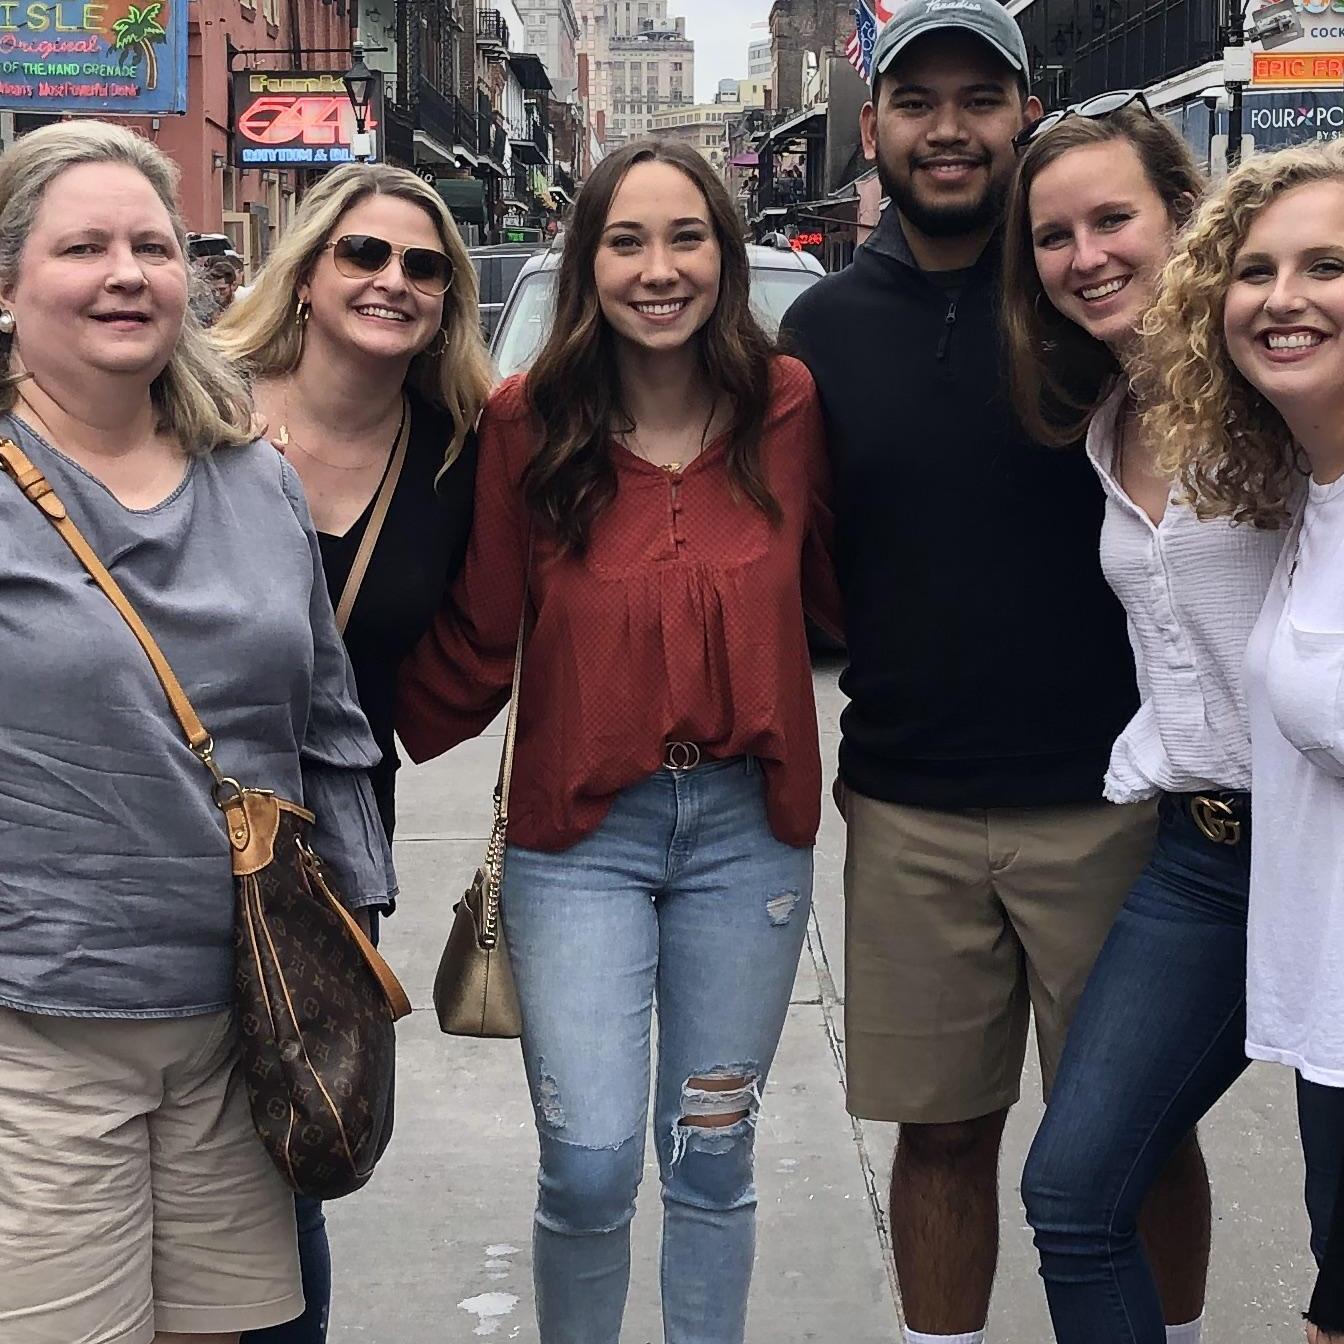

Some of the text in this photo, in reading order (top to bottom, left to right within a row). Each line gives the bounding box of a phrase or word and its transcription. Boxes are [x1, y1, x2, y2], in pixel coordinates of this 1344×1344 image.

[3, 62, 19, 73] OF
[23, 63, 46, 75] THE
[48, 63, 80, 76] HAND
[82, 63, 137, 78] GRENADE
[1256, 58, 1305, 77] EPIC
[249, 74, 348, 93] Funk
[238, 96, 379, 145] 544
[1251, 108, 1296, 129] FOUR
[1316, 130, 1329, 140] BY
[242, 148, 313, 162] RHYTHM
[314, 148, 328, 162] &
